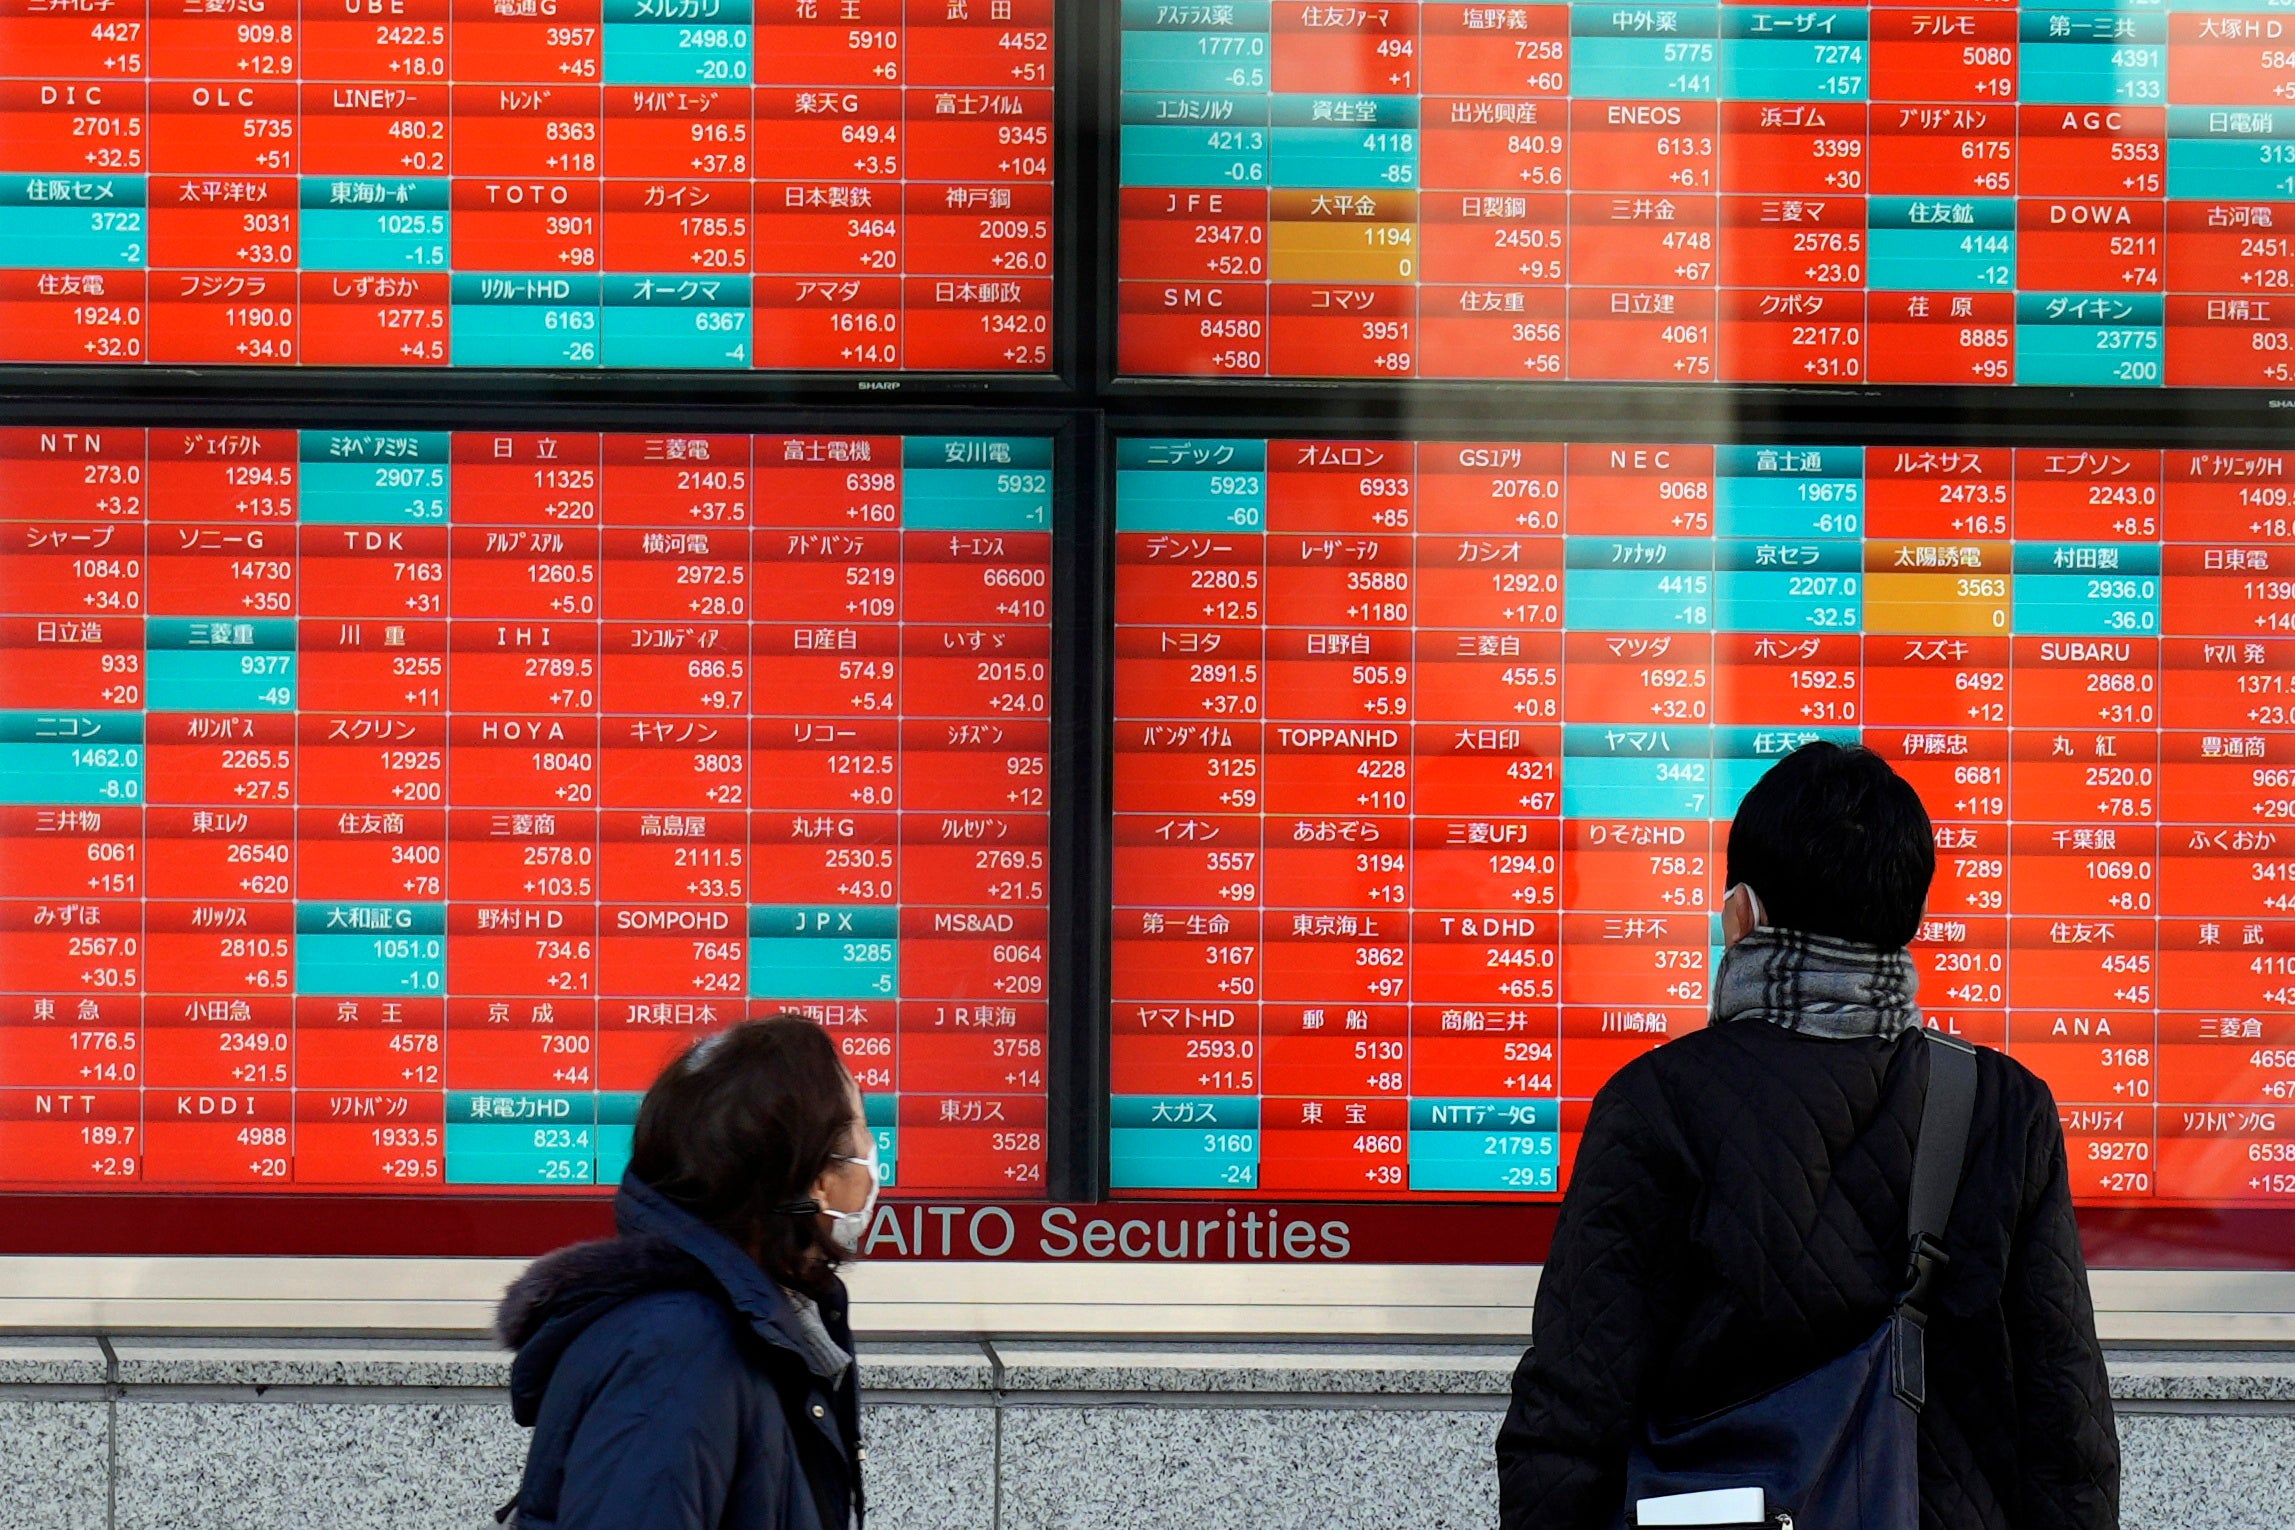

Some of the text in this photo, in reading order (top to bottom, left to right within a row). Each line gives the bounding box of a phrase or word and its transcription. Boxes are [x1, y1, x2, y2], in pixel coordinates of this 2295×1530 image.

[1464, 9, 1527, 29] 塩野義
[1751, 14, 1837, 34] エーザイ
[2050, 15, 2136, 39] 第一三共
[91, 23, 140, 41] 4427
[377, 26, 444, 44] 2422.5
[680, 30, 746, 48] 2498.0
[999, 33, 1047, 50] 4452
[1199, 37, 1264, 56] 1777.0
[1516, 41, 1563, 59] 7258
[1813, 45, 1862, 64] 7274
[2112, 48, 2159, 68] 4391
[1224, 68, 1265, 89] -6.5
[1313, 101, 1376, 121] 資生堂
[1609, 106, 1680, 124] ENEOS
[244, 119, 292, 137] 5735
[547, 122, 595, 140] 8363
[842, 125, 896, 143] 649.4
[1364, 134, 1414, 154] 4118
[1658, 138, 1711, 155] 613.3
[1962, 142, 2010, 159] 6175
[256, 151, 289, 168] +51
[546, 154, 595, 171] +118
[27, 179, 113, 200] 住阪セメ
[645, 186, 709, 206] ガイシ
[946, 187, 1010, 208] 神戸鋼
[1463, 197, 1525, 217] 日製鋼
[1761, 201, 1824, 221] 三菱マ
[92, 212, 140, 231] 3722
[378, 215, 443, 234] 1025.5
[681, 218, 745, 236] 1785.5
[980, 221, 1046, 238] 2009.5
[1196, 226, 1261, 243] 2347.0
[1495, 229, 1561, 247] 2450.5
[1794, 233, 1860, 251] 2576.5
[2111, 237, 2155, 255] 5211
[1207, 256, 1261, 274] +52.0
[2122, 268, 2157, 285] +74
[182, 276, 265, 296] フジクラ
[797, 281, 860, 301] アマダ
[1312, 291, 1374, 309] コマツ
[1612, 293, 1674, 313] 日立建
[227, 308, 292, 326] 1190.0
[2208, 300, 2270, 320] 日精工
[545, 311, 594, 329] 6163
[831, 314, 895, 331] 1616.0
[1363, 322, 1408, 339] 3951
[1662, 326, 1707, 343] 4061
[1960, 329, 2008, 347] 8885
[563, 342, 594, 360] -26
[1972, 360, 2008, 377] +95
[645, 439, 709, 460] 三菱電
[946, 442, 1011, 463] 安川電
[1148, 444, 1234, 464] ニデック
[1756, 449, 1823, 473] 富士通
[2045, 452, 2130, 474] エプソン
[85, 465, 139, 483] 273.0
[376, 468, 443, 487] 2907.5
[678, 472, 744, 489] 2140.5
[998, 475, 1045, 493] 5932
[1211, 476, 1258, 495] 5923
[1492, 480, 1558, 498] 2076.0
[1797, 483, 1858, 501] 19675
[2089, 487, 2155, 504] 2243.0
[97, 496, 139, 514] +3.2
[1895, 546, 1981, 567] 太陽誘電
[2205, 549, 2268, 570] 日東電
[232, 562, 290, 579] 14730
[528, 565, 593, 582] 1260.5
[847, 568, 894, 585] 5219
[1348, 572, 1407, 590] 35880
[1658, 576, 1707, 595] 4415
[1958, 579, 2005, 597] 3563
[846, 598, 894, 616] +109
[1347, 604, 1407, 621] +1180
[38, 622, 101, 642] 日立造
[1163, 632, 1220, 652] トヨタ
[1458, 635, 1519, 655] 三菱自
[1755, 638, 1820, 658] ホンダ
[2042, 643, 2129, 661] SUBARU
[102, 655, 138, 672] 933
[394, 657, 441, 675] 3255
[689, 660, 743, 678] 686.5
[978, 663, 1044, 680] 2015.0
[1191, 665, 1256, 682] 2891.5
[1502, 668, 1556, 685] 455.5
[1791, 671, 1855, 689] 1592.5
[2087, 674, 2153, 691] 2868.0
[701, 691, 742, 708] +9.7
[795, 724, 856, 742] リコー
[1278, 729, 1397, 747] TOPPANHD
[1605, 729, 1669, 753] ヤマハ
[1903, 734, 1967, 754] 伊藤忠
[2202, 736, 2265, 757] 豊通商
[222, 750, 289, 768] 2265.5
[533, 753, 591, 770] 18040
[828, 756, 893, 773] 1212.5
[1357, 761, 1405, 778] 4228
[1656, 763, 1707, 785] 3442
[1955, 766, 2000, 784] 6681
[36, 810, 100, 831] 三井物
[338, 813, 403, 834] 住友商
[642, 814, 705, 836] 高島屋
[1156, 820, 1219, 840] イオン
[2052, 829, 2115, 849] 千葉銀
[88, 843, 134, 861] 6061
[392, 846, 440, 863] 3400
[675, 848, 741, 866] 2111.5
[976, 851, 1042, 868] 2769.5
[1207, 853, 1255, 870] 3557
[1490, 856, 1554, 873] 1294.0
[2087, 862, 2151, 879] 1069.0
[988, 882, 1042, 899] +21.5
[618, 911, 728, 929] SOMPOHD
[936, 914, 1013, 931] MS&AD
[1293, 914, 1378, 936] 東京海上
[1604, 918, 1667, 938] 三井不
[221, 939, 288, 956] 2810.5
[536, 941, 590, 959] 734.6
[844, 944, 892, 962] 3285
[1356, 948, 1403, 966] 3862
[1655, 951, 1702, 968] 3732
[1935, 953, 2002, 973] 2301.0
[548, 972, 587, 989] +2.1
[1442, 1009, 1527, 1031] 商船三井
[70, 1032, 135, 1050] 1776.5
[390, 1034, 438, 1052] 4578
[994, 1039, 1041, 1056] 3758
[1187, 1040, 1253, 1058] 2593.0
[1505, 1043, 1552, 1061] 5294
[2102, 1049, 2149, 1066] 3168
[1005, 1070, 1040, 1087] +14
[940, 1099, 1004, 1121] 東ガス
[1152, 1102, 1217, 1122] 大ガス
[237, 1128, 286, 1145] 4988
[534, 1130, 588, 1147] 823.4
[1353, 1136, 1401, 1153] 4860
[2089, 1142, 2148, 1160] 39270
[250, 1159, 286, 1176] +20
[539, 1160, 588, 1179] -25.2
[1366, 1166, 1401, 1183] +39
[2100, 1173, 2148, 1191] +270
[865, 1205, 1351, 1258] AITO Securities
